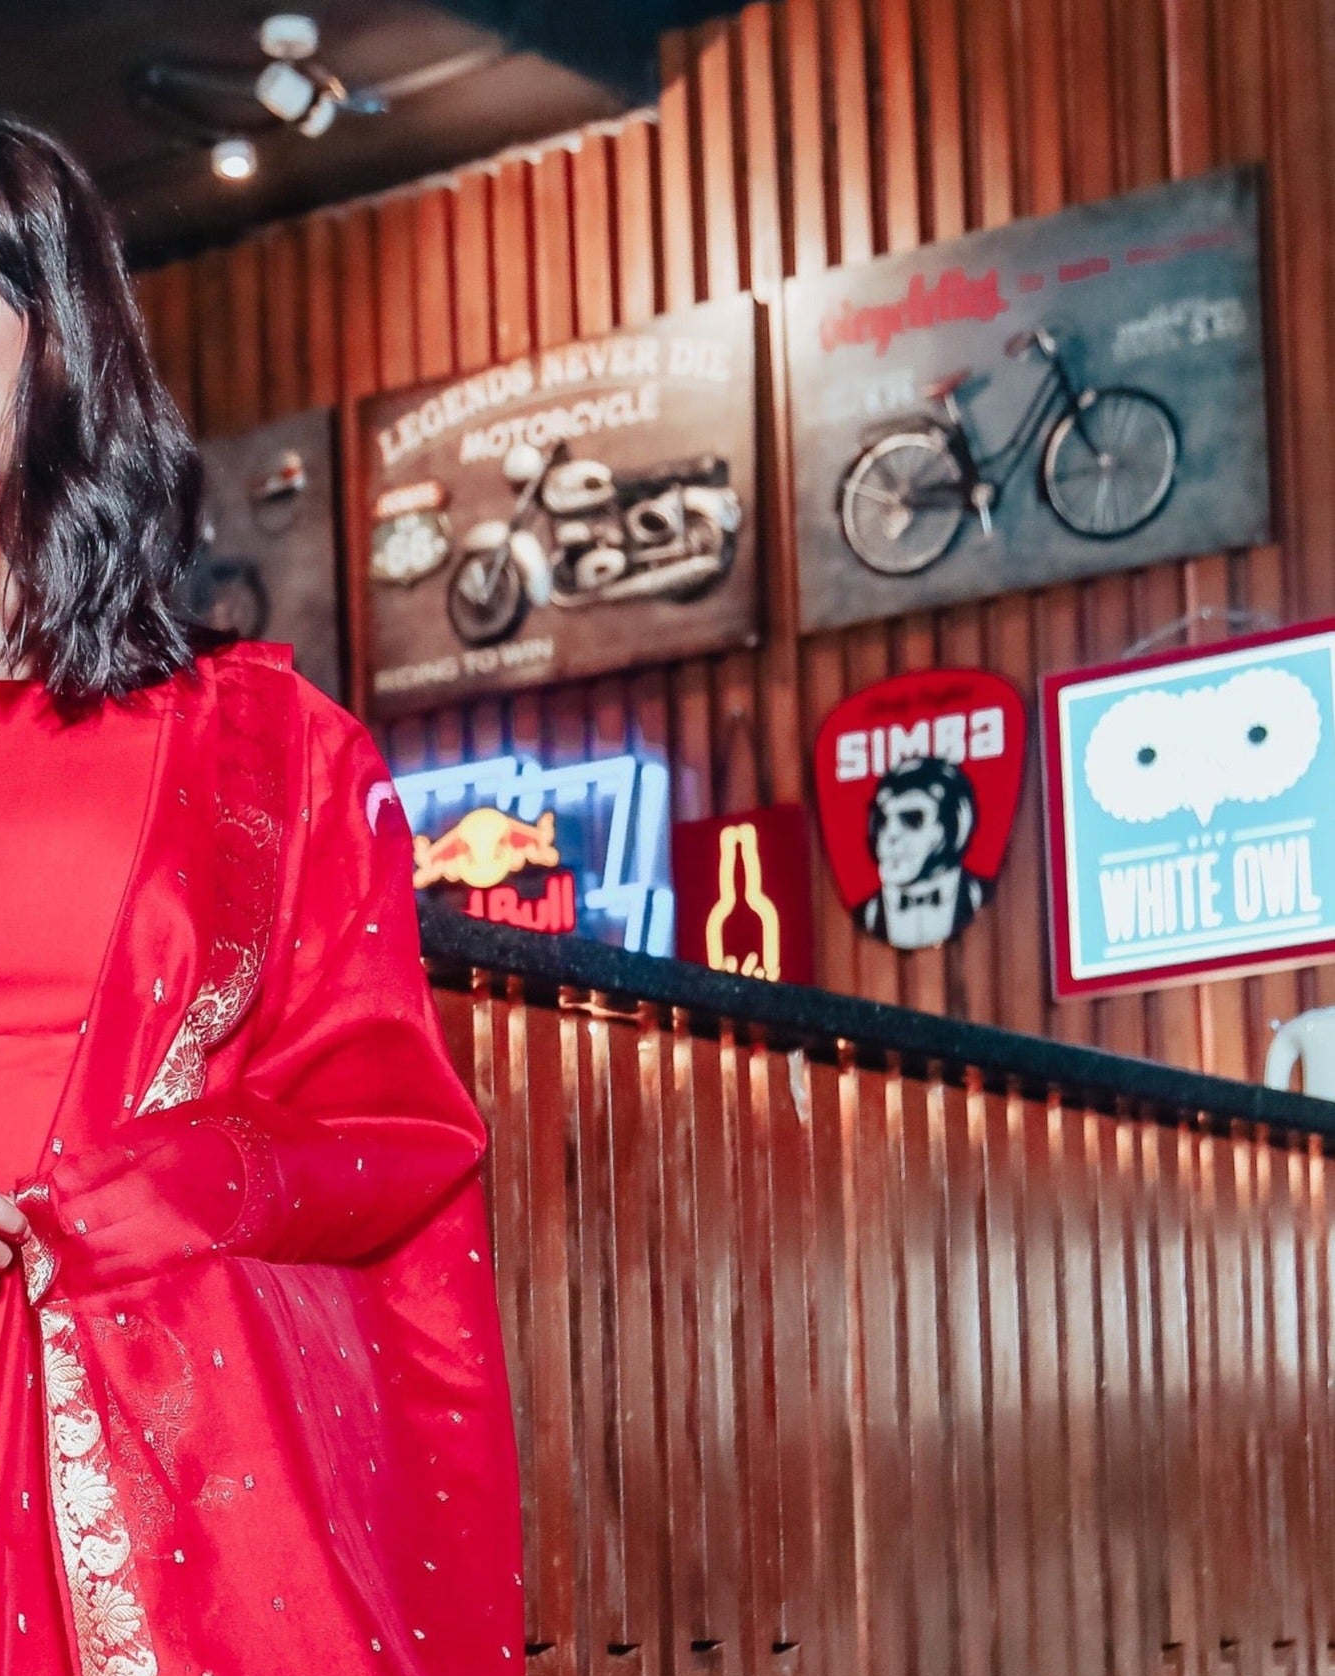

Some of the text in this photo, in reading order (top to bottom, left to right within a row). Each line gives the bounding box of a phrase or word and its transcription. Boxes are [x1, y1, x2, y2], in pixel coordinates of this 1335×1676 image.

[379, 333, 733, 468] LEGENDS NEVER DIE
[459, 381, 661, 466] MOTORCYCLE
[835, 704, 1006, 783] SIMBA
[1097, 834, 1323, 945] WHITE OWL
